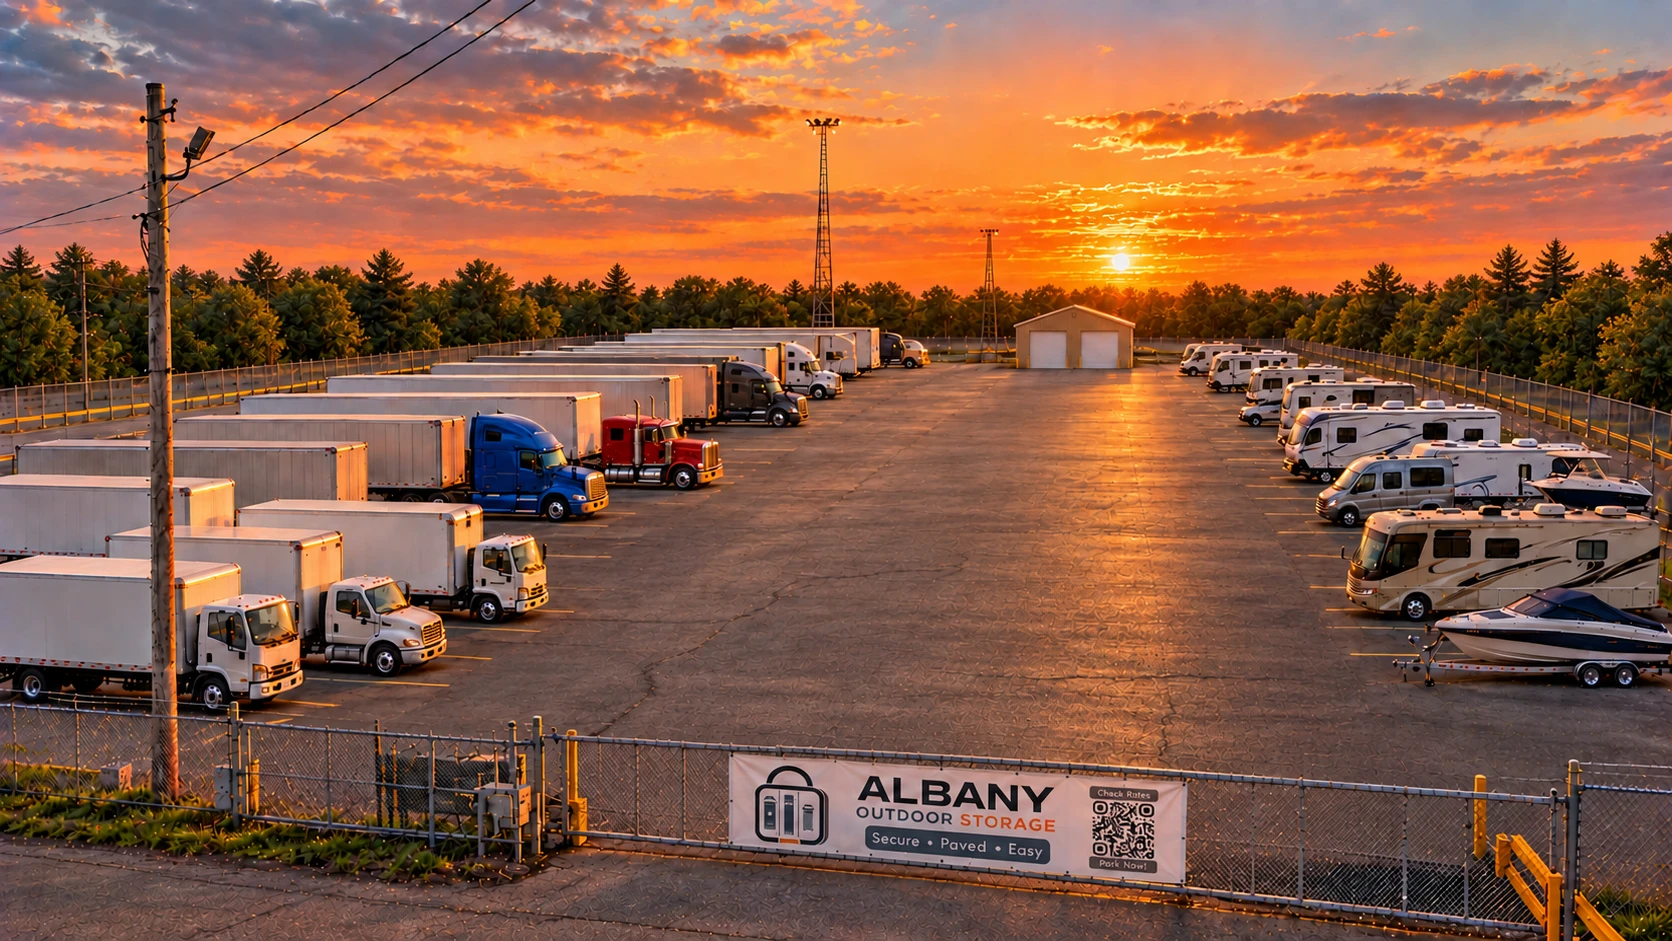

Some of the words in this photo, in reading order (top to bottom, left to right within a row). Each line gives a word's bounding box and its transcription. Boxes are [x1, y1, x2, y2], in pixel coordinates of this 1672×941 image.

[858, 776, 1054, 813] ALBANY
[856, 806, 952, 825] OUTDOOR
[960, 813, 1056, 832] STORAGE
[872, 832, 920, 847] Secure
[940, 837, 987, 853] Paved
[1008, 843, 1043, 860] Easy
